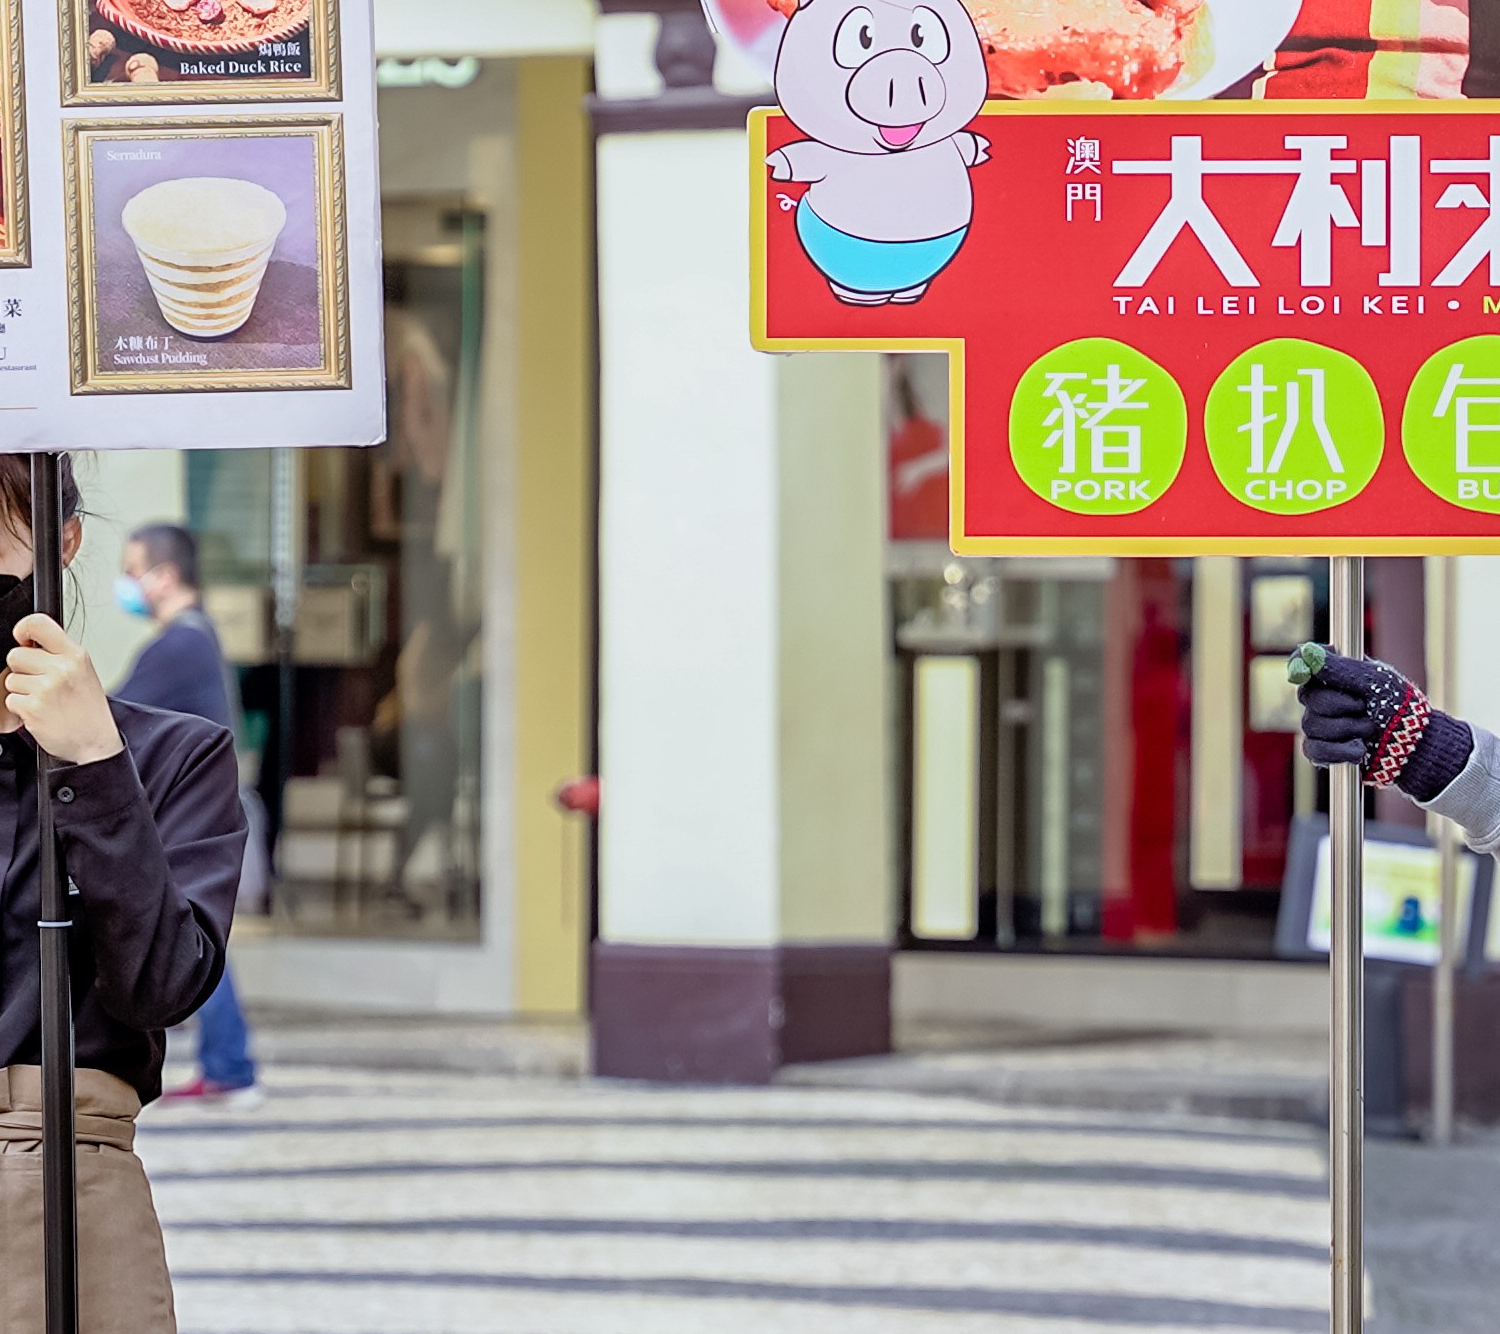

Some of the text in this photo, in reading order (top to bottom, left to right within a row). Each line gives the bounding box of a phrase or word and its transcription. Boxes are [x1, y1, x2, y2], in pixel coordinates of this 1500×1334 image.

[179, 58, 302, 75] Baked Duck Rice
[1065, 137, 1102, 221] 澳門
[1113, 295, 1177, 315] TAI
[1197, 295, 1256, 315] LEI
[1277, 295, 1340, 315] LOI
[1363, 295, 1427, 315] KEI
[113, 351, 208, 366] Sawdust Pudding
[1051, 479, 1152, 501] PORK
[1244, 479, 1347, 501] CHOP
